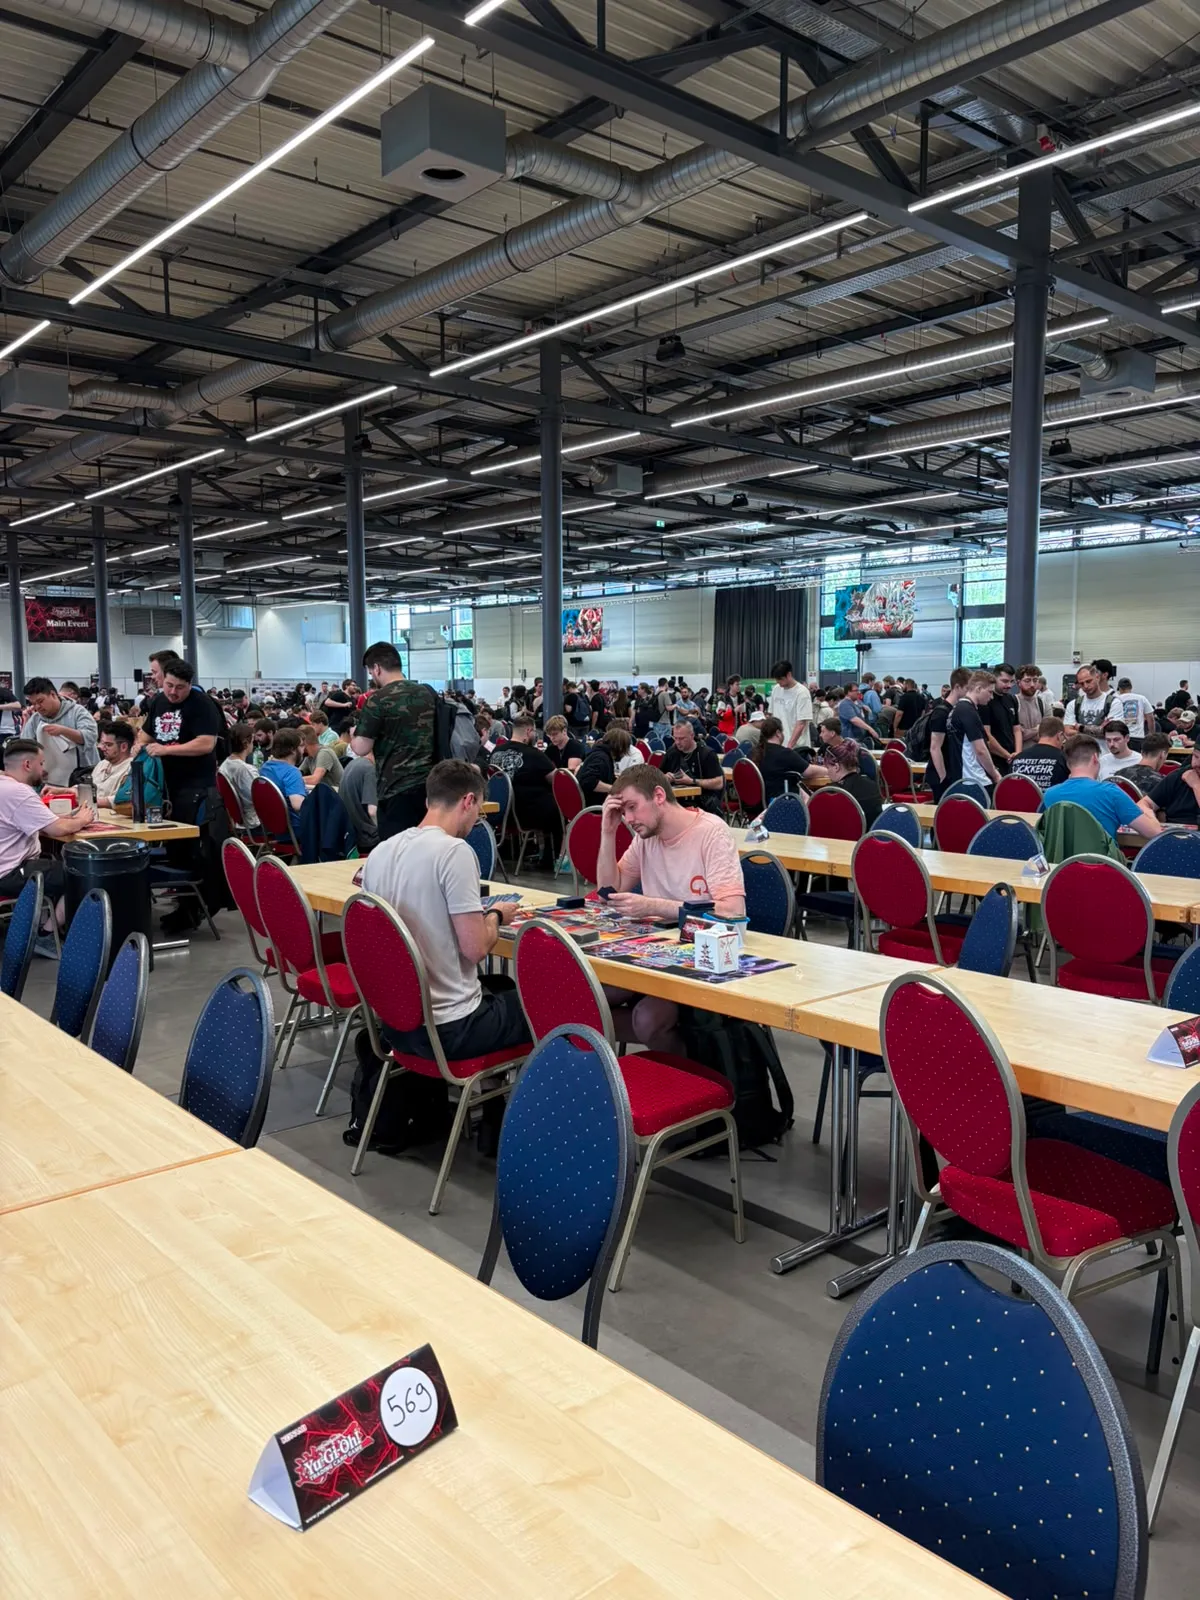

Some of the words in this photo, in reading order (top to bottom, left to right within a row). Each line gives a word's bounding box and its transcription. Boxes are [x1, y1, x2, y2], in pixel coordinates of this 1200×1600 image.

[46, 620, 67, 628] Main
[67, 620, 89, 628] Event
[387, 1382, 432, 1427] 569
